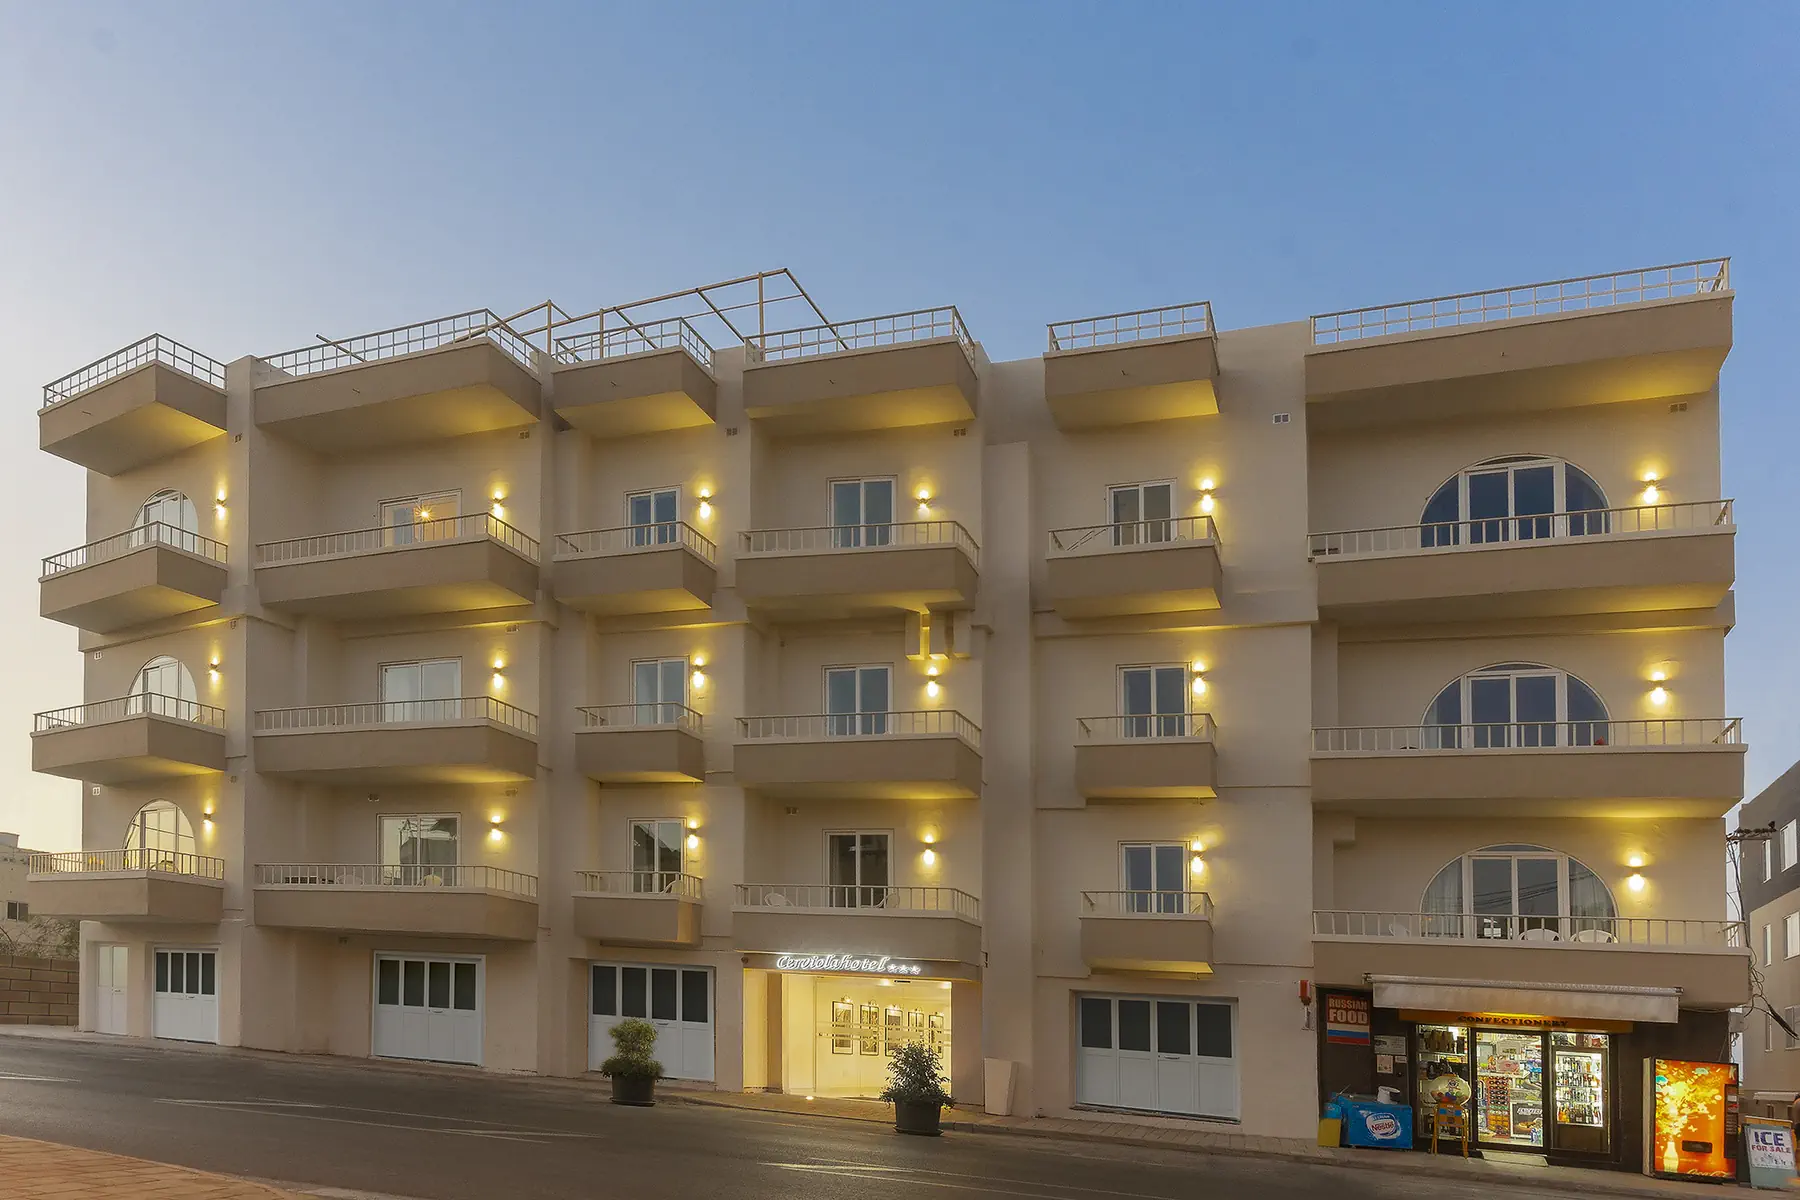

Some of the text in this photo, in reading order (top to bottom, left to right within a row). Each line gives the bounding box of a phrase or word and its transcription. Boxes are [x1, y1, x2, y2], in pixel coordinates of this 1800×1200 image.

[1328, 998, 1368, 1011] RUSSIAN
[1328, 1008, 1368, 1024] FOOD
[1458, 1016, 1568, 1027] CONFECTIONERY
[1754, 1131, 1784, 1146] ICE
